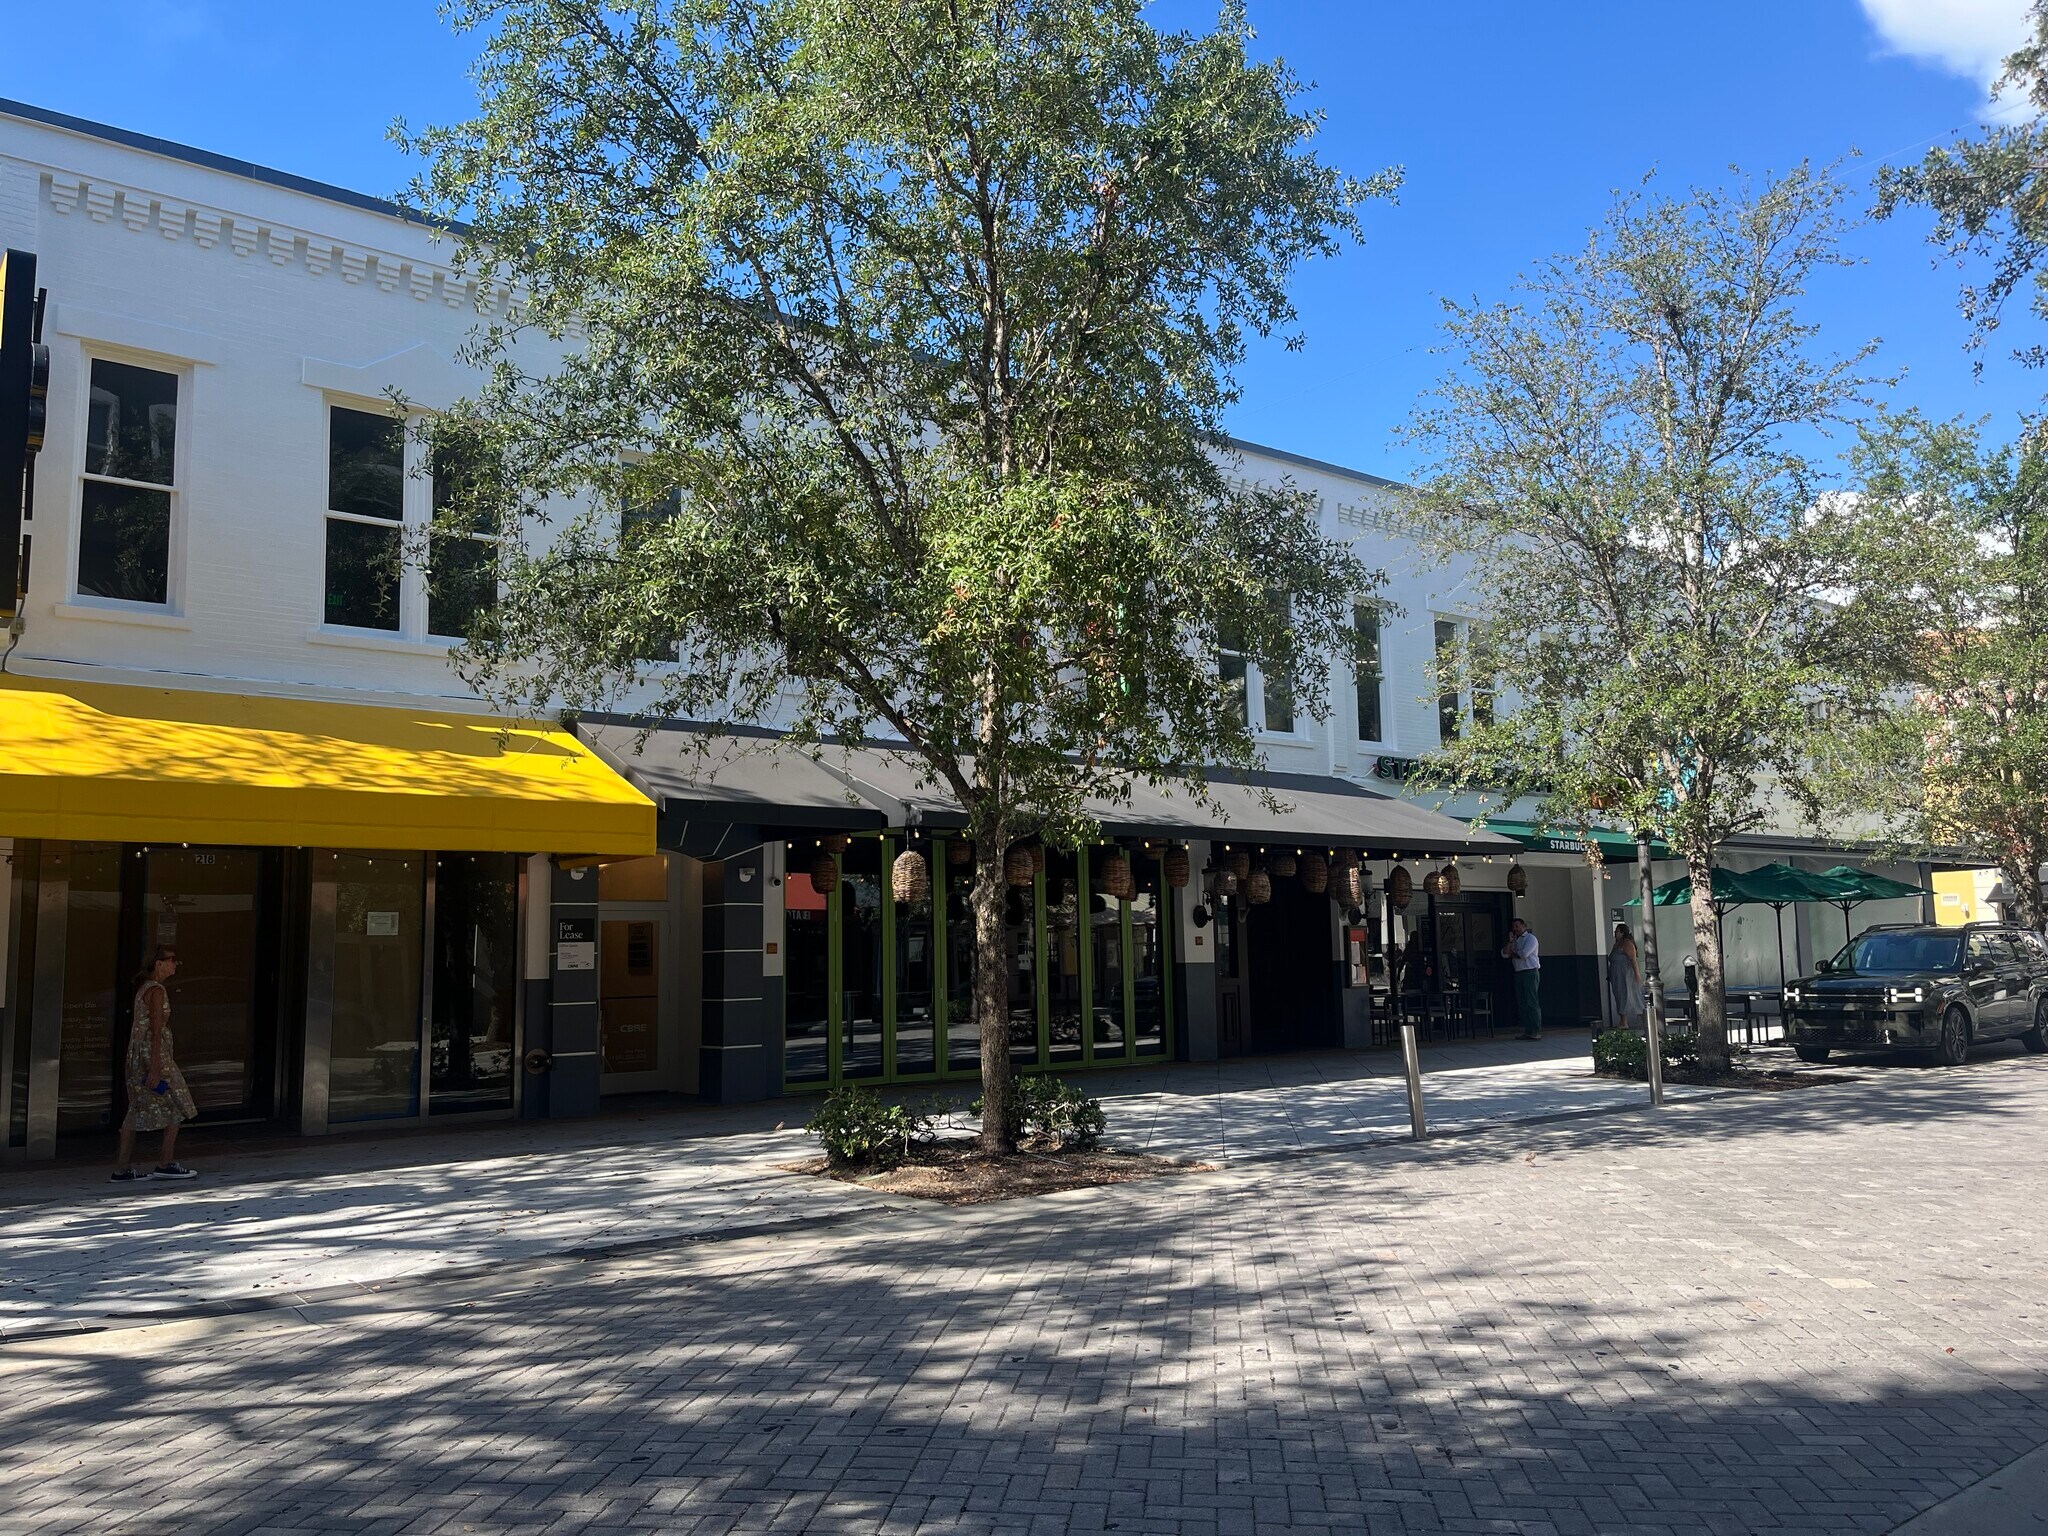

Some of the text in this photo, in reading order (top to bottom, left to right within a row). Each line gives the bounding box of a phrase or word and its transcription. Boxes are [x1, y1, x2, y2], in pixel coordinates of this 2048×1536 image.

[328, 593, 344, 606] EXIT
[1550, 840, 1588, 852] STARBUC
[197, 854, 214, 864] 218
[559, 922, 574, 931] For
[559, 931, 584, 940] Lease
[620, 1024, 648, 1033] CBRE
